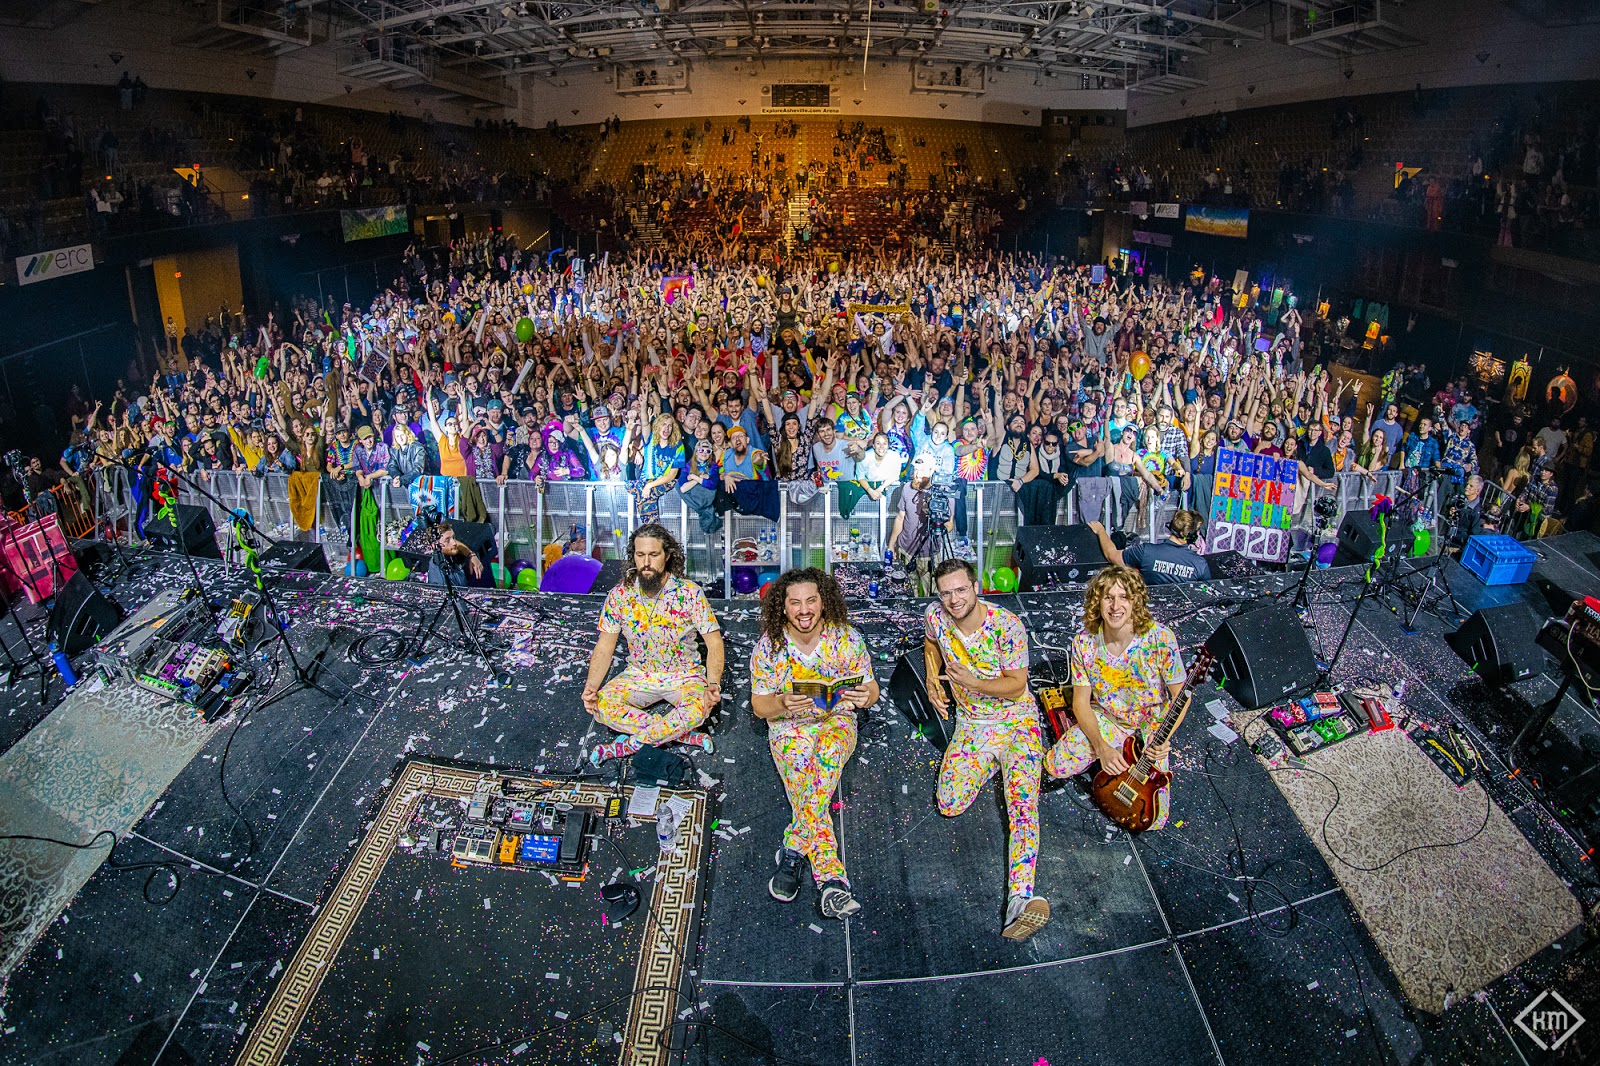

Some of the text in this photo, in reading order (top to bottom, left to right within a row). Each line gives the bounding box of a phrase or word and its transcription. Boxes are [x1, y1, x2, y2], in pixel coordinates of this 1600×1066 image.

[1165, 204, 1178, 214] erc
[55, 248, 88, 269] erc
[1217, 448, 1298, 484] PIGEONS
[1212, 521, 1283, 560] 2020
[1152, 560, 1195, 578] EVENT STAFF
